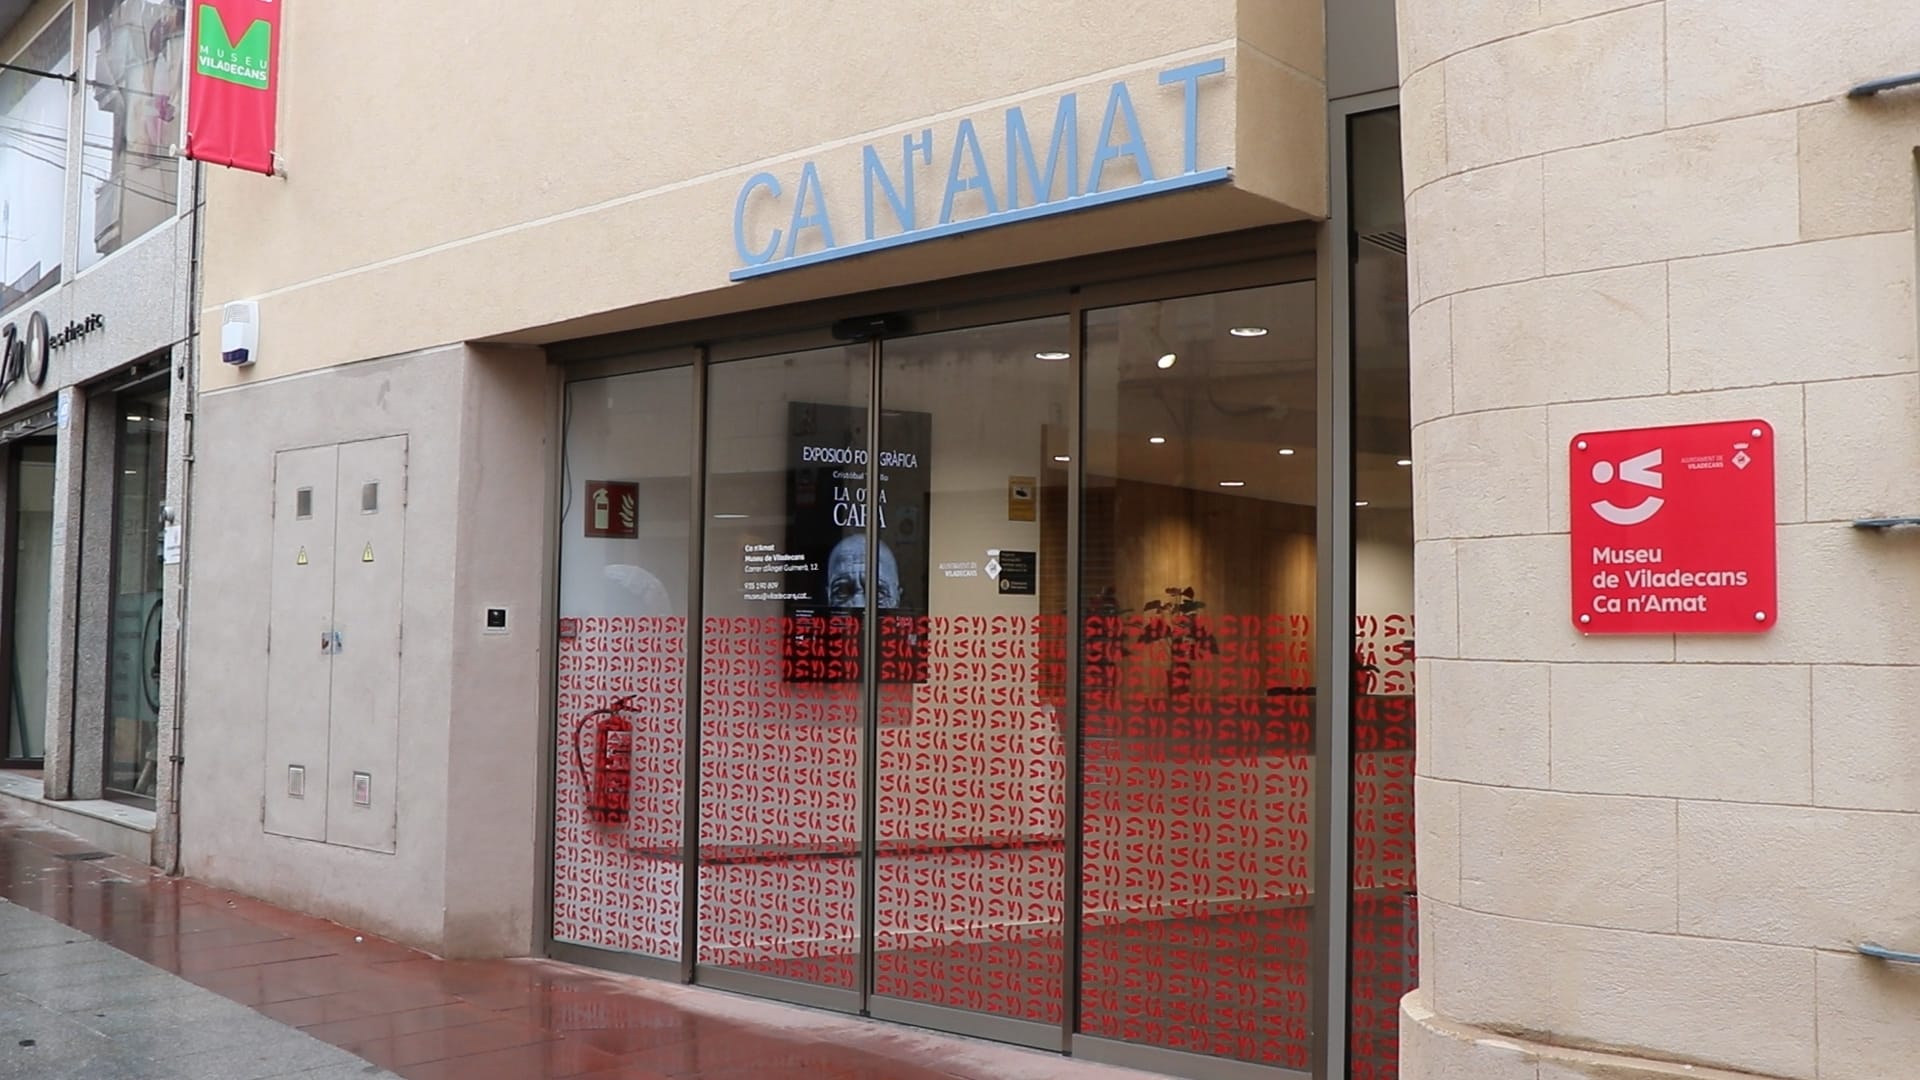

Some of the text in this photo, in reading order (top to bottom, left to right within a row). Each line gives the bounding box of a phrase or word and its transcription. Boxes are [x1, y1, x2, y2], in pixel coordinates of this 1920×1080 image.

[200, 45, 267, 69] MUSEU
[199, 56, 267, 80] VILADECANS
[734, 161, 836, 266] CA
[803, 446, 918, 468] EXPOSICIÓ FOGRÀFICA
[834, 486, 887, 503] LA OA
[1592, 547, 1662, 564] Museu
[1592, 569, 1748, 588] de Viladecans
[1592, 594, 1707, 613] Ca n'Amat
